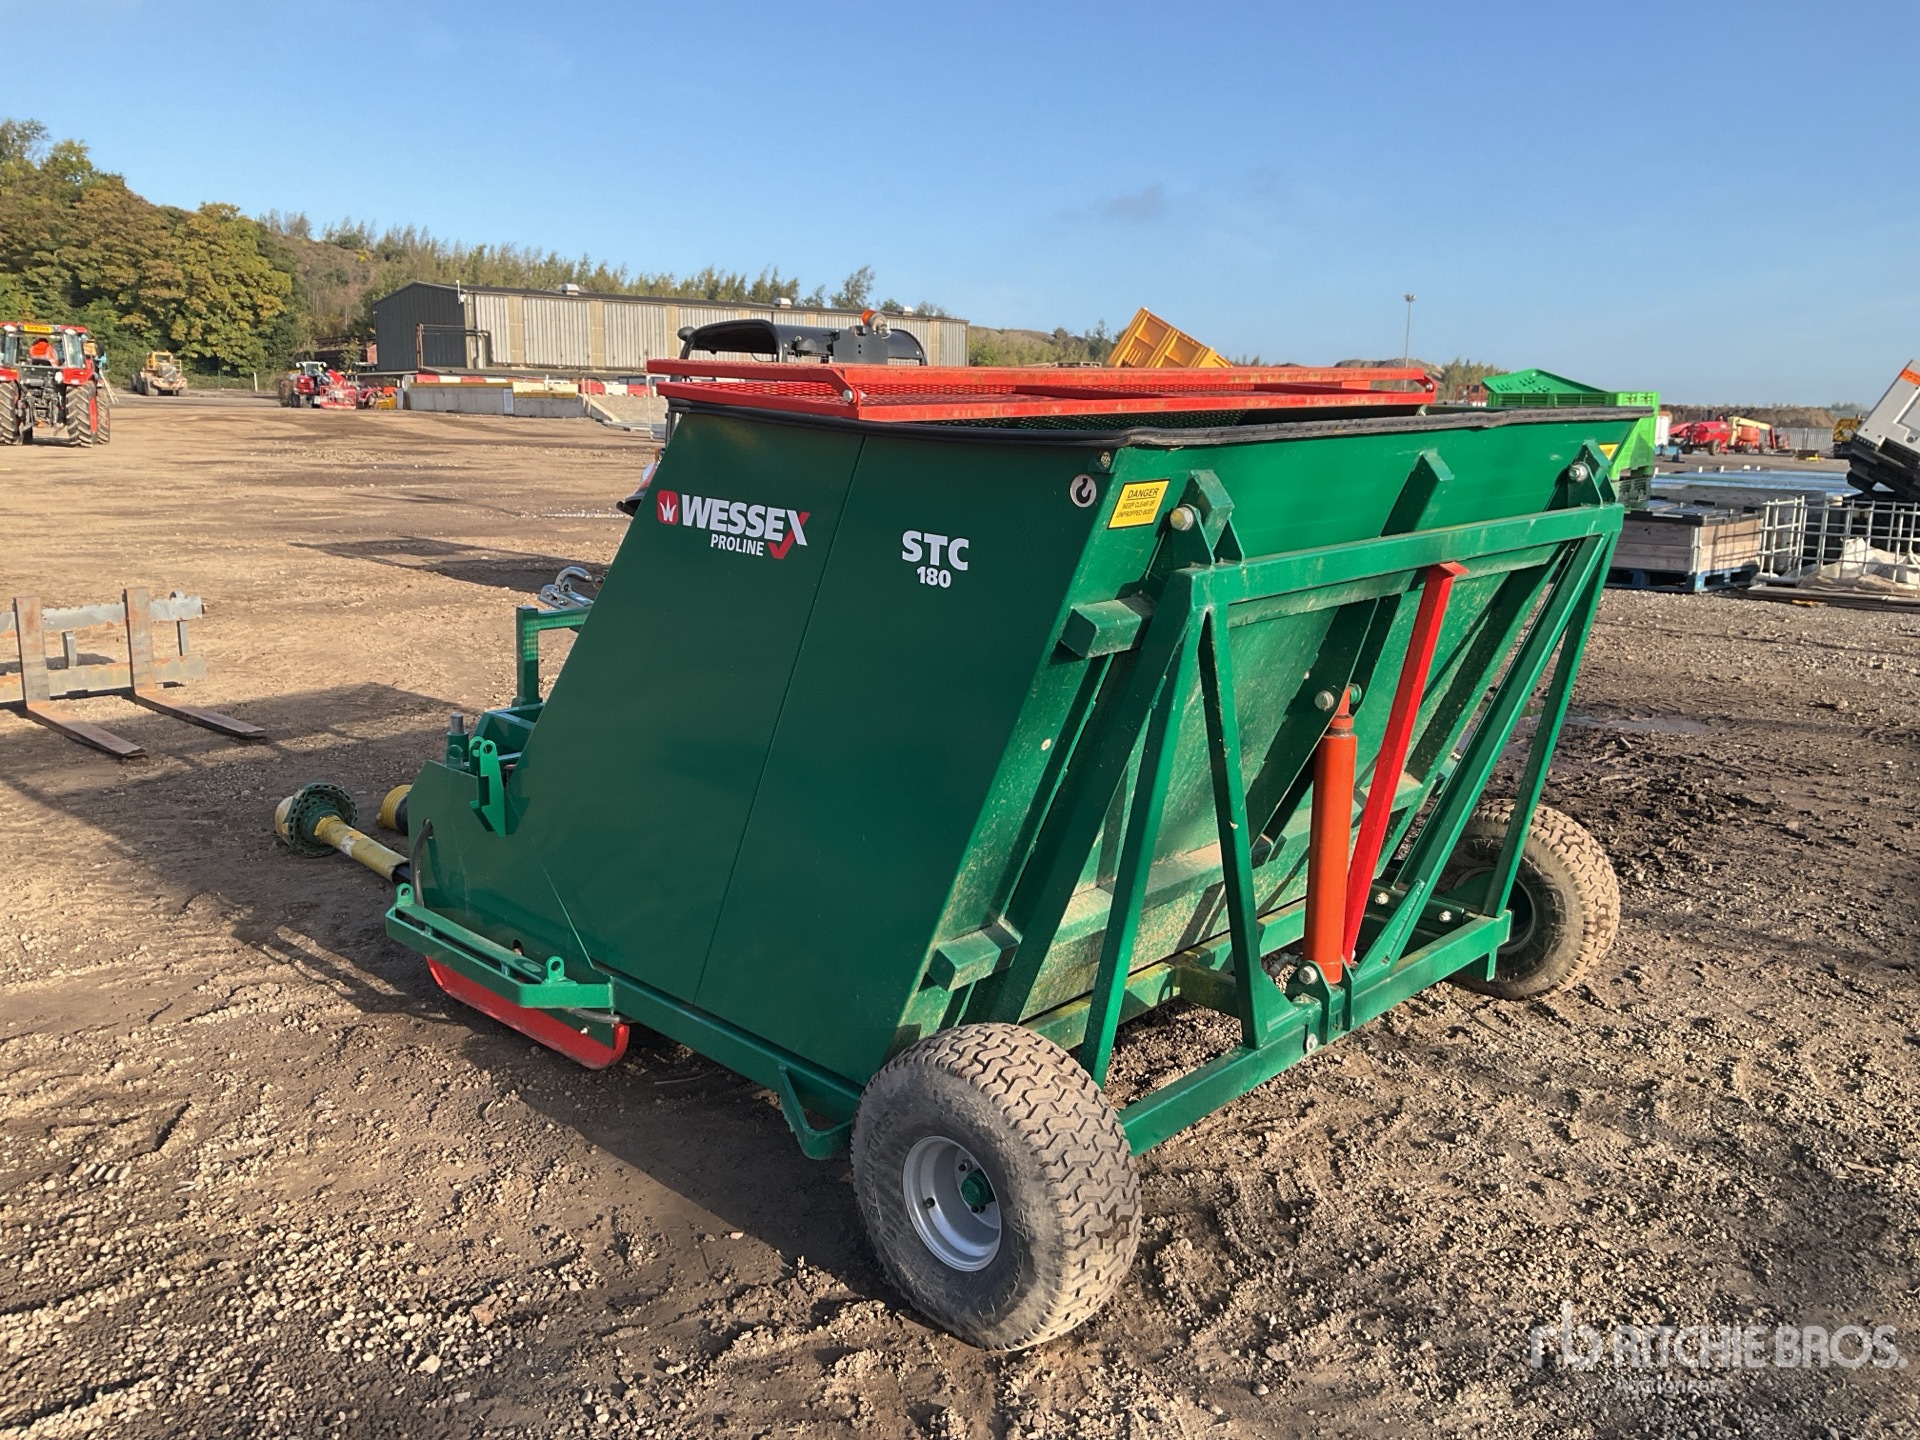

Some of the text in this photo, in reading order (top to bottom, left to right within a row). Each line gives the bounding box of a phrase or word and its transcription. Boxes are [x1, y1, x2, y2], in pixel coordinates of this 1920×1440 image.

[1127, 488, 1159, 498] DANGER
[682, 494, 810, 559] WESSEX
[710, 534, 764, 556] PROLINE
[902, 530, 969, 571] STC
[917, 566, 951, 588] 180
